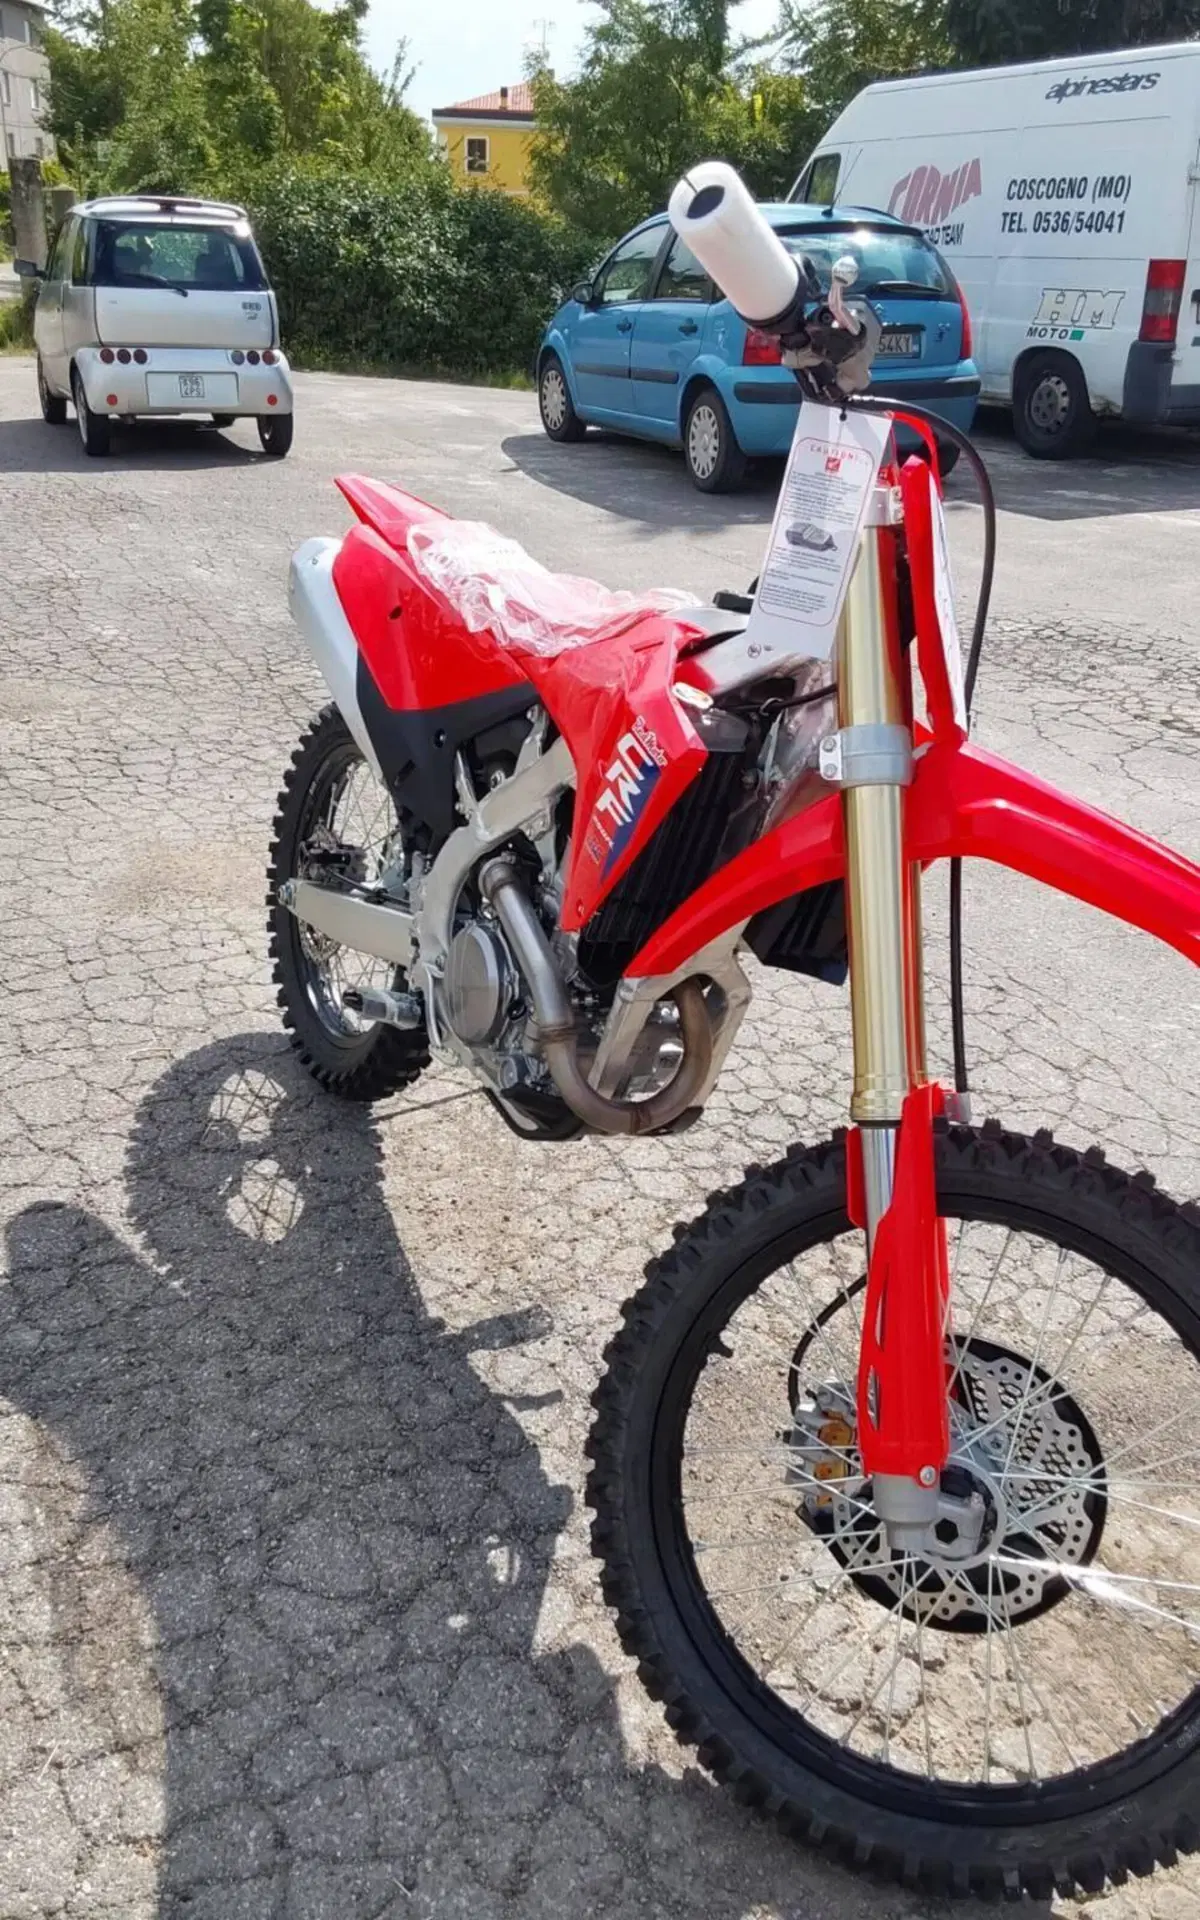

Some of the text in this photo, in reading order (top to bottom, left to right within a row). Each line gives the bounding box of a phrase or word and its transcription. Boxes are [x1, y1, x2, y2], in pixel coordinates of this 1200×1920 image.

[1045, 73, 1161, 104] alpinestars
[1007, 175, 1132, 204] COSCOGNO (MO)
[941, 222, 964, 245] TEAM
[1001, 210, 1126, 235] TEL. 0536/54041
[1026, 327, 1069, 340] MOTO
[597, 733, 654, 826] CRF
